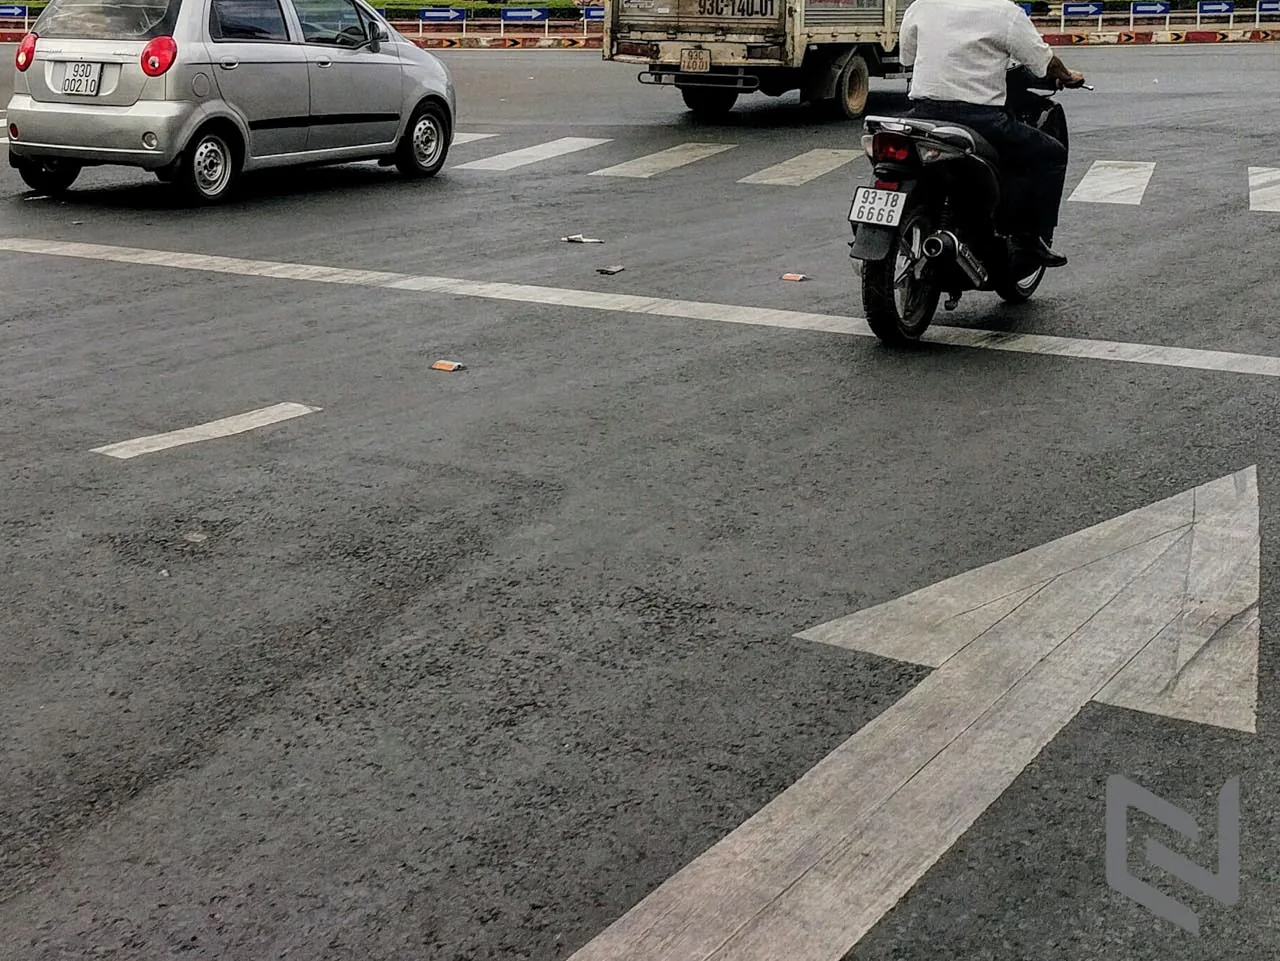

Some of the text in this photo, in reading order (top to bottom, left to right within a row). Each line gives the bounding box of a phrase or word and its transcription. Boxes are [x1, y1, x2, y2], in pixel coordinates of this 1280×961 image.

[687, 50, 704, 60] 93C
[72, 63, 92, 78] 93D
[861, 189, 900, 208] 93-T8
[856, 205, 896, 224] 6666
